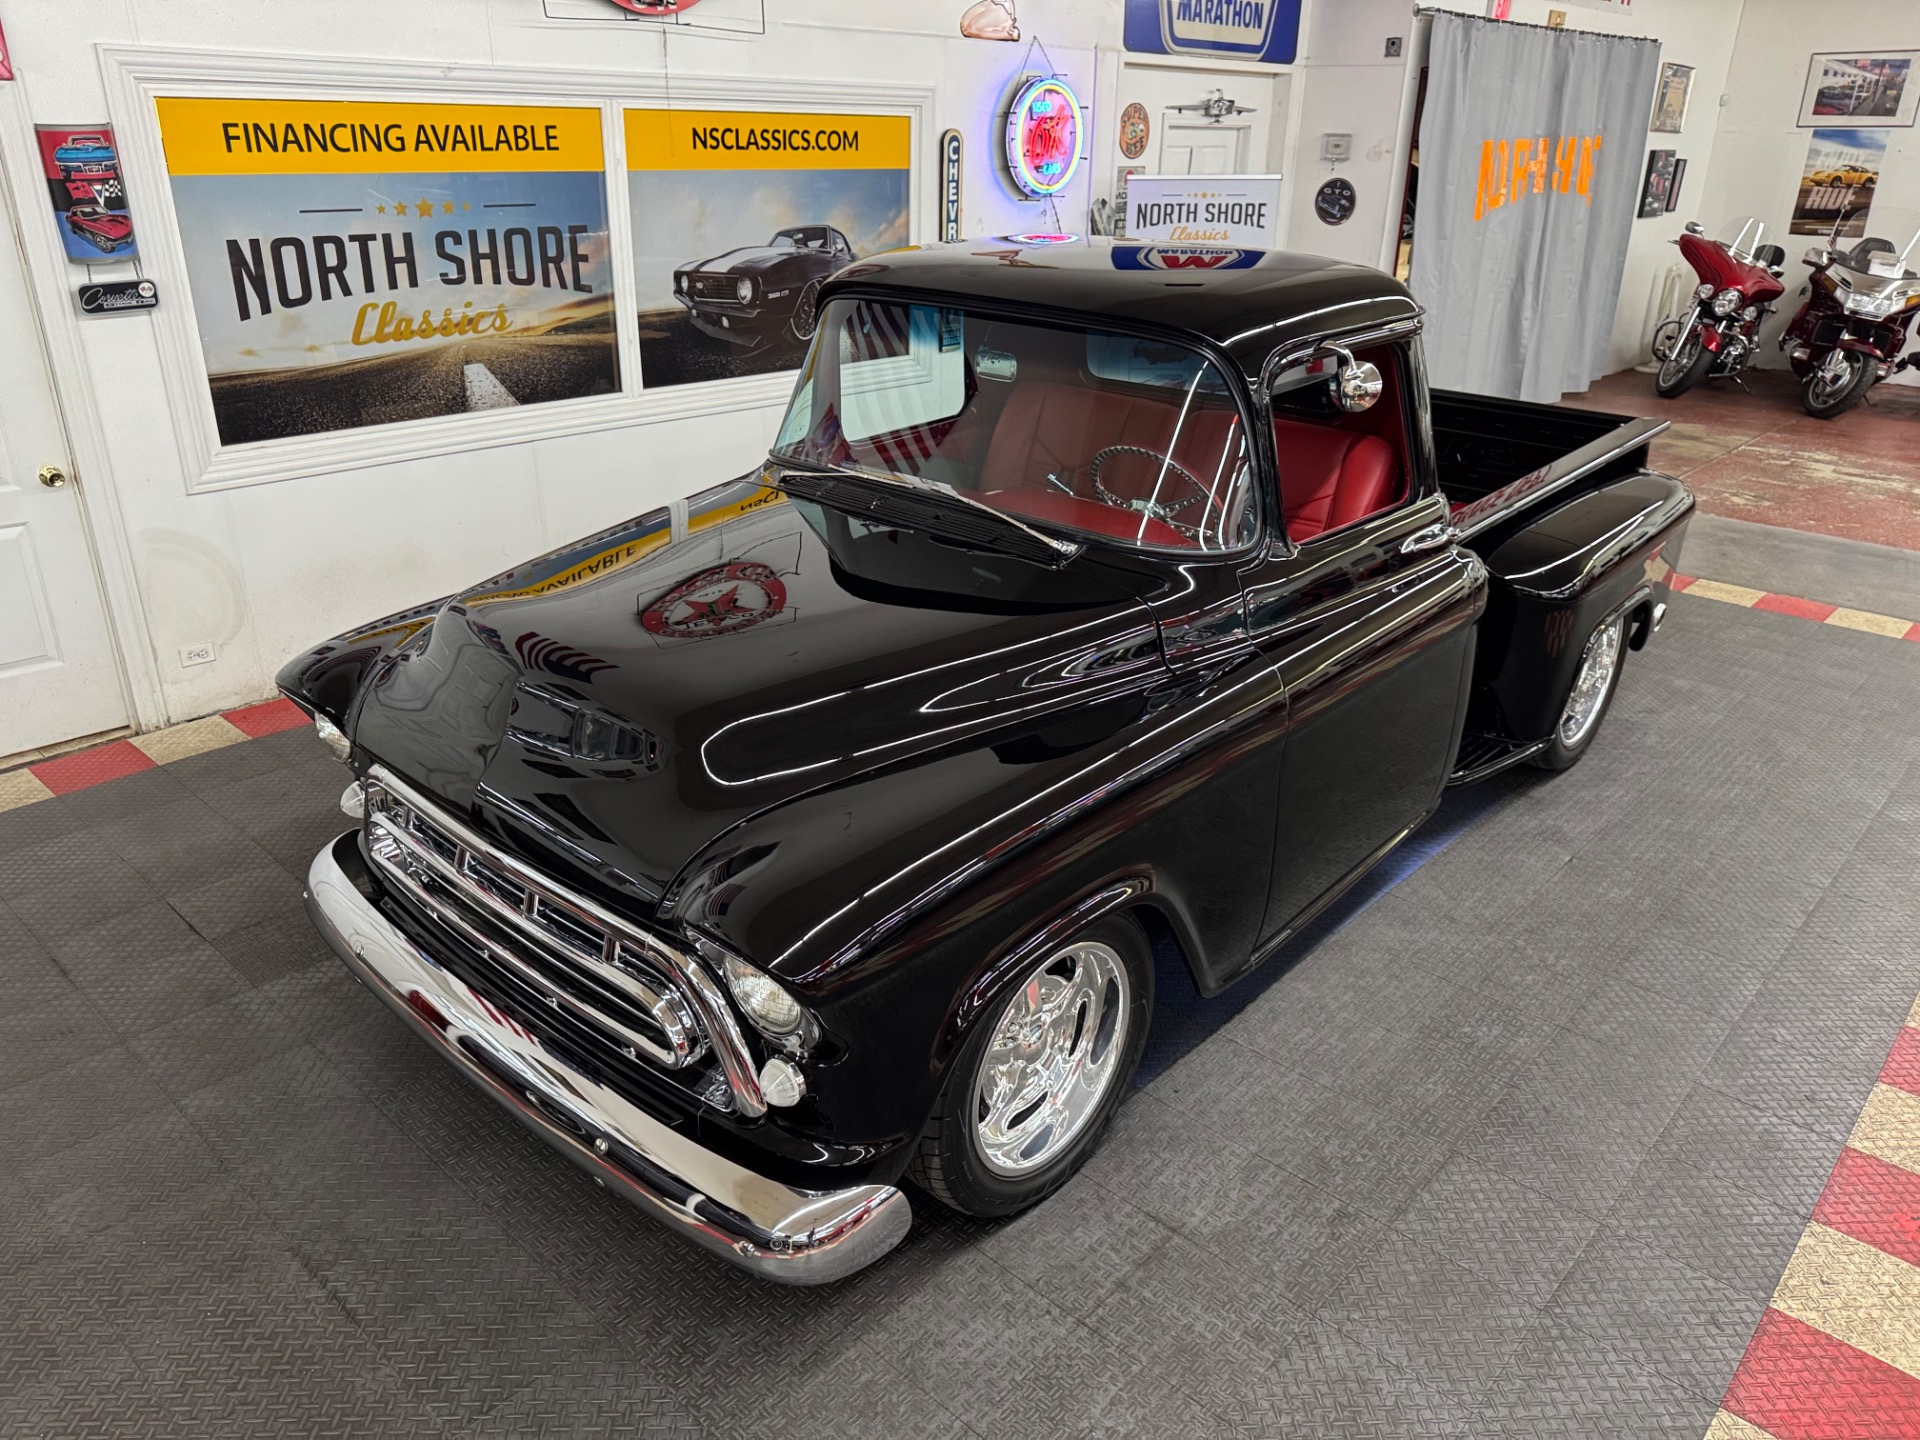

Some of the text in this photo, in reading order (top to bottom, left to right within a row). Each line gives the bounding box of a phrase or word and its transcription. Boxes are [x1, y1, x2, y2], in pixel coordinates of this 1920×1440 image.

[1177, 0, 1264, 29] MARATHON
[222, 122, 560, 153] FINANCING AVAILABLE
[692, 127, 859, 151] NSCLASSICS.COM
[1126, 136, 1145, 156] BEE
[1323, 187, 1351, 196] GTO
[1136, 203, 1198, 229] NORTH
[1204, 203, 1267, 229] SHORE
[1169, 226, 1229, 241] Classics
[226, 224, 594, 322] NORTH SHORE
[82, 287, 142, 309] Corvette
[351, 301, 513, 346] Classics
